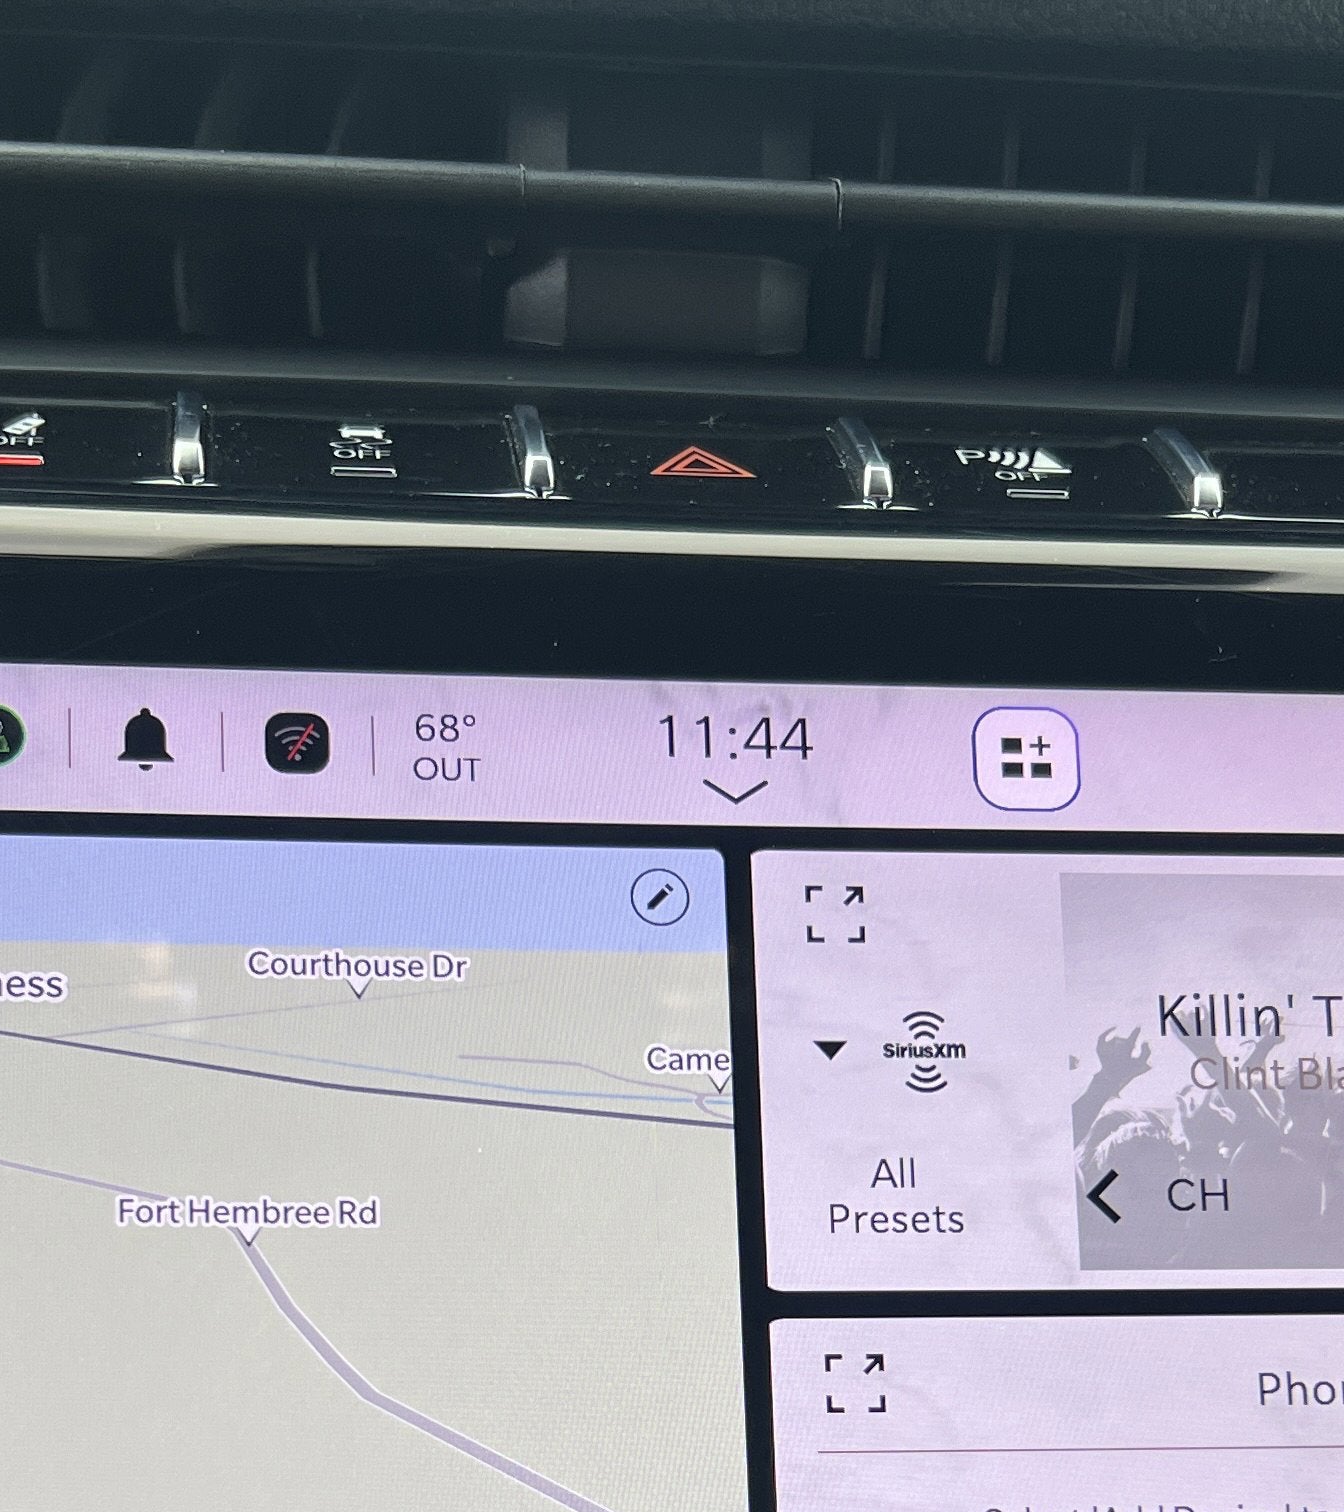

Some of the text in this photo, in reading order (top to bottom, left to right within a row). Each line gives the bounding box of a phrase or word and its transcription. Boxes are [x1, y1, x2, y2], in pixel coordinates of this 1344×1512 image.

[333, 448, 392, 460] OFF
[994, 470, 1049, 482] OFF
[415, 712, 477, 743] 68°
[658, 714, 814, 761] 11:44
[413, 756, 482, 783] OUT
[248, 950, 467, 980] Courthouse Dr
[1157, 993, 1295, 1038] Killin'
[1190, 1057, 1285, 1092] Clint
[870, 1156, 916, 1189] All
[116, 1192, 378, 1227] Fort Hembree Rd
[1167, 1178, 1230, 1212] CH
[829, 1203, 965, 1234] Presets
